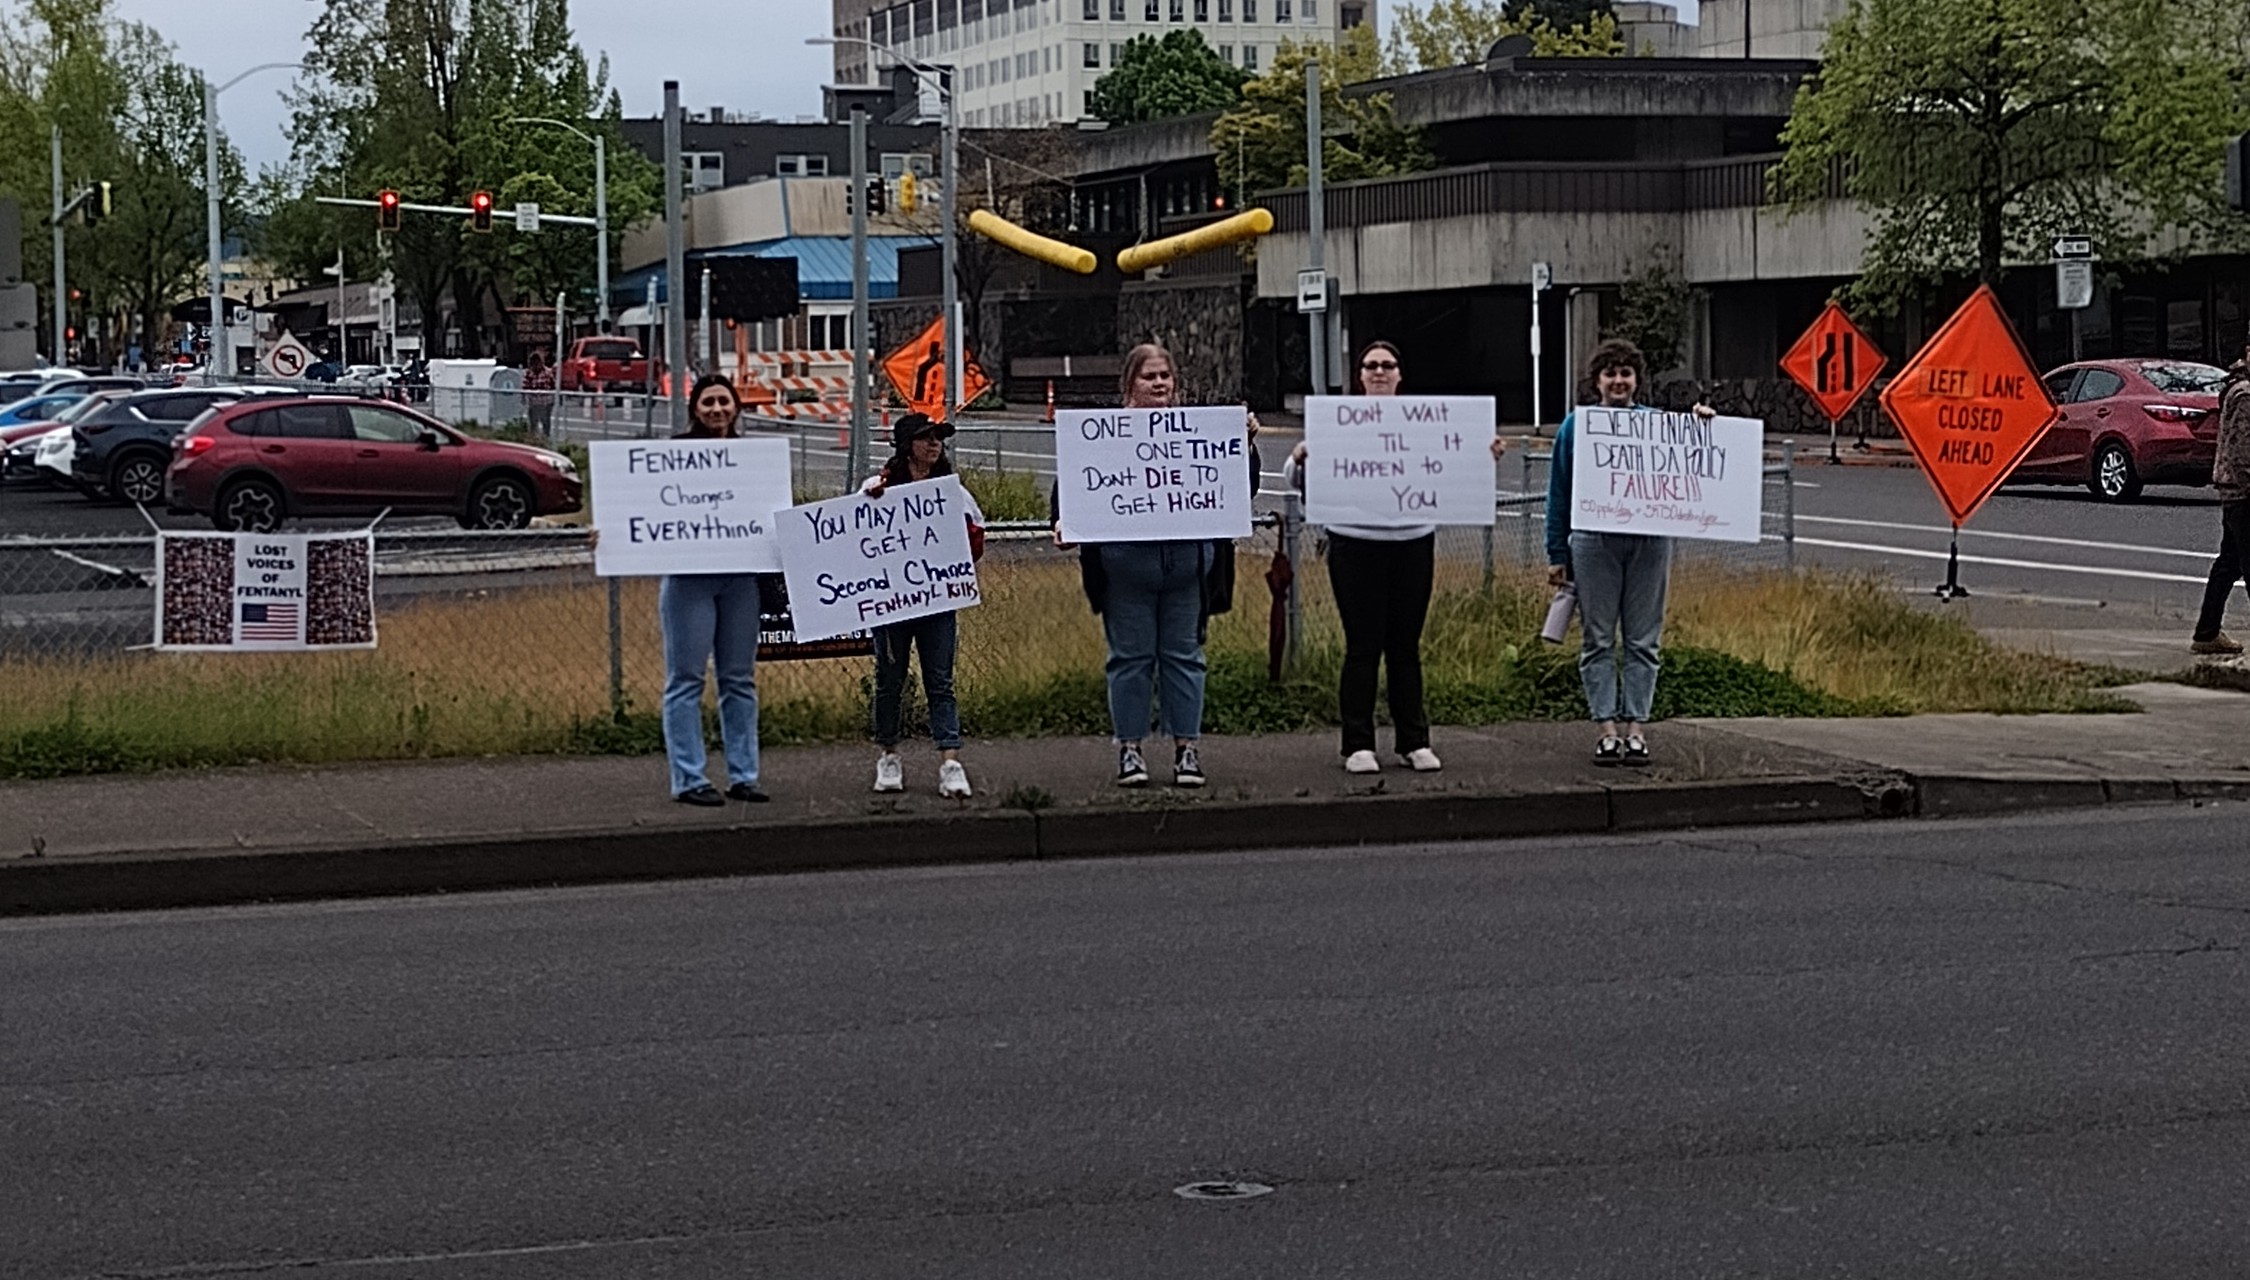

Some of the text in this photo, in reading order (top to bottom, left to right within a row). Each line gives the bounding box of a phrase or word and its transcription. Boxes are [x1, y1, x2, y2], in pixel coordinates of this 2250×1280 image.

[1928, 369, 2025, 399] LEFT LANE
[1081, 415, 1132, 441] ONE
[1586, 409, 1646, 440] EVERY
[1938, 404, 2003, 432] CLOSED
[1136, 441, 1182, 461] ONE
[1593, 442, 1645, 472] DEATH
[1669, 446, 1680, 473] A
[1684, 445, 1726, 481] POLICY
[1938, 440, 1994, 466] AHEAD
[1333, 458, 1405, 479] HAPPEN
[660, 483, 735, 510] Changes
[924, 526, 940, 546] A
[254, 544, 288, 557] LOST
[246, 558, 295, 570] VOICES
[261, 573, 280, 584] OF
[817, 559, 974, 605] Second Chance
[237, 586, 304, 598] FENTANYL
